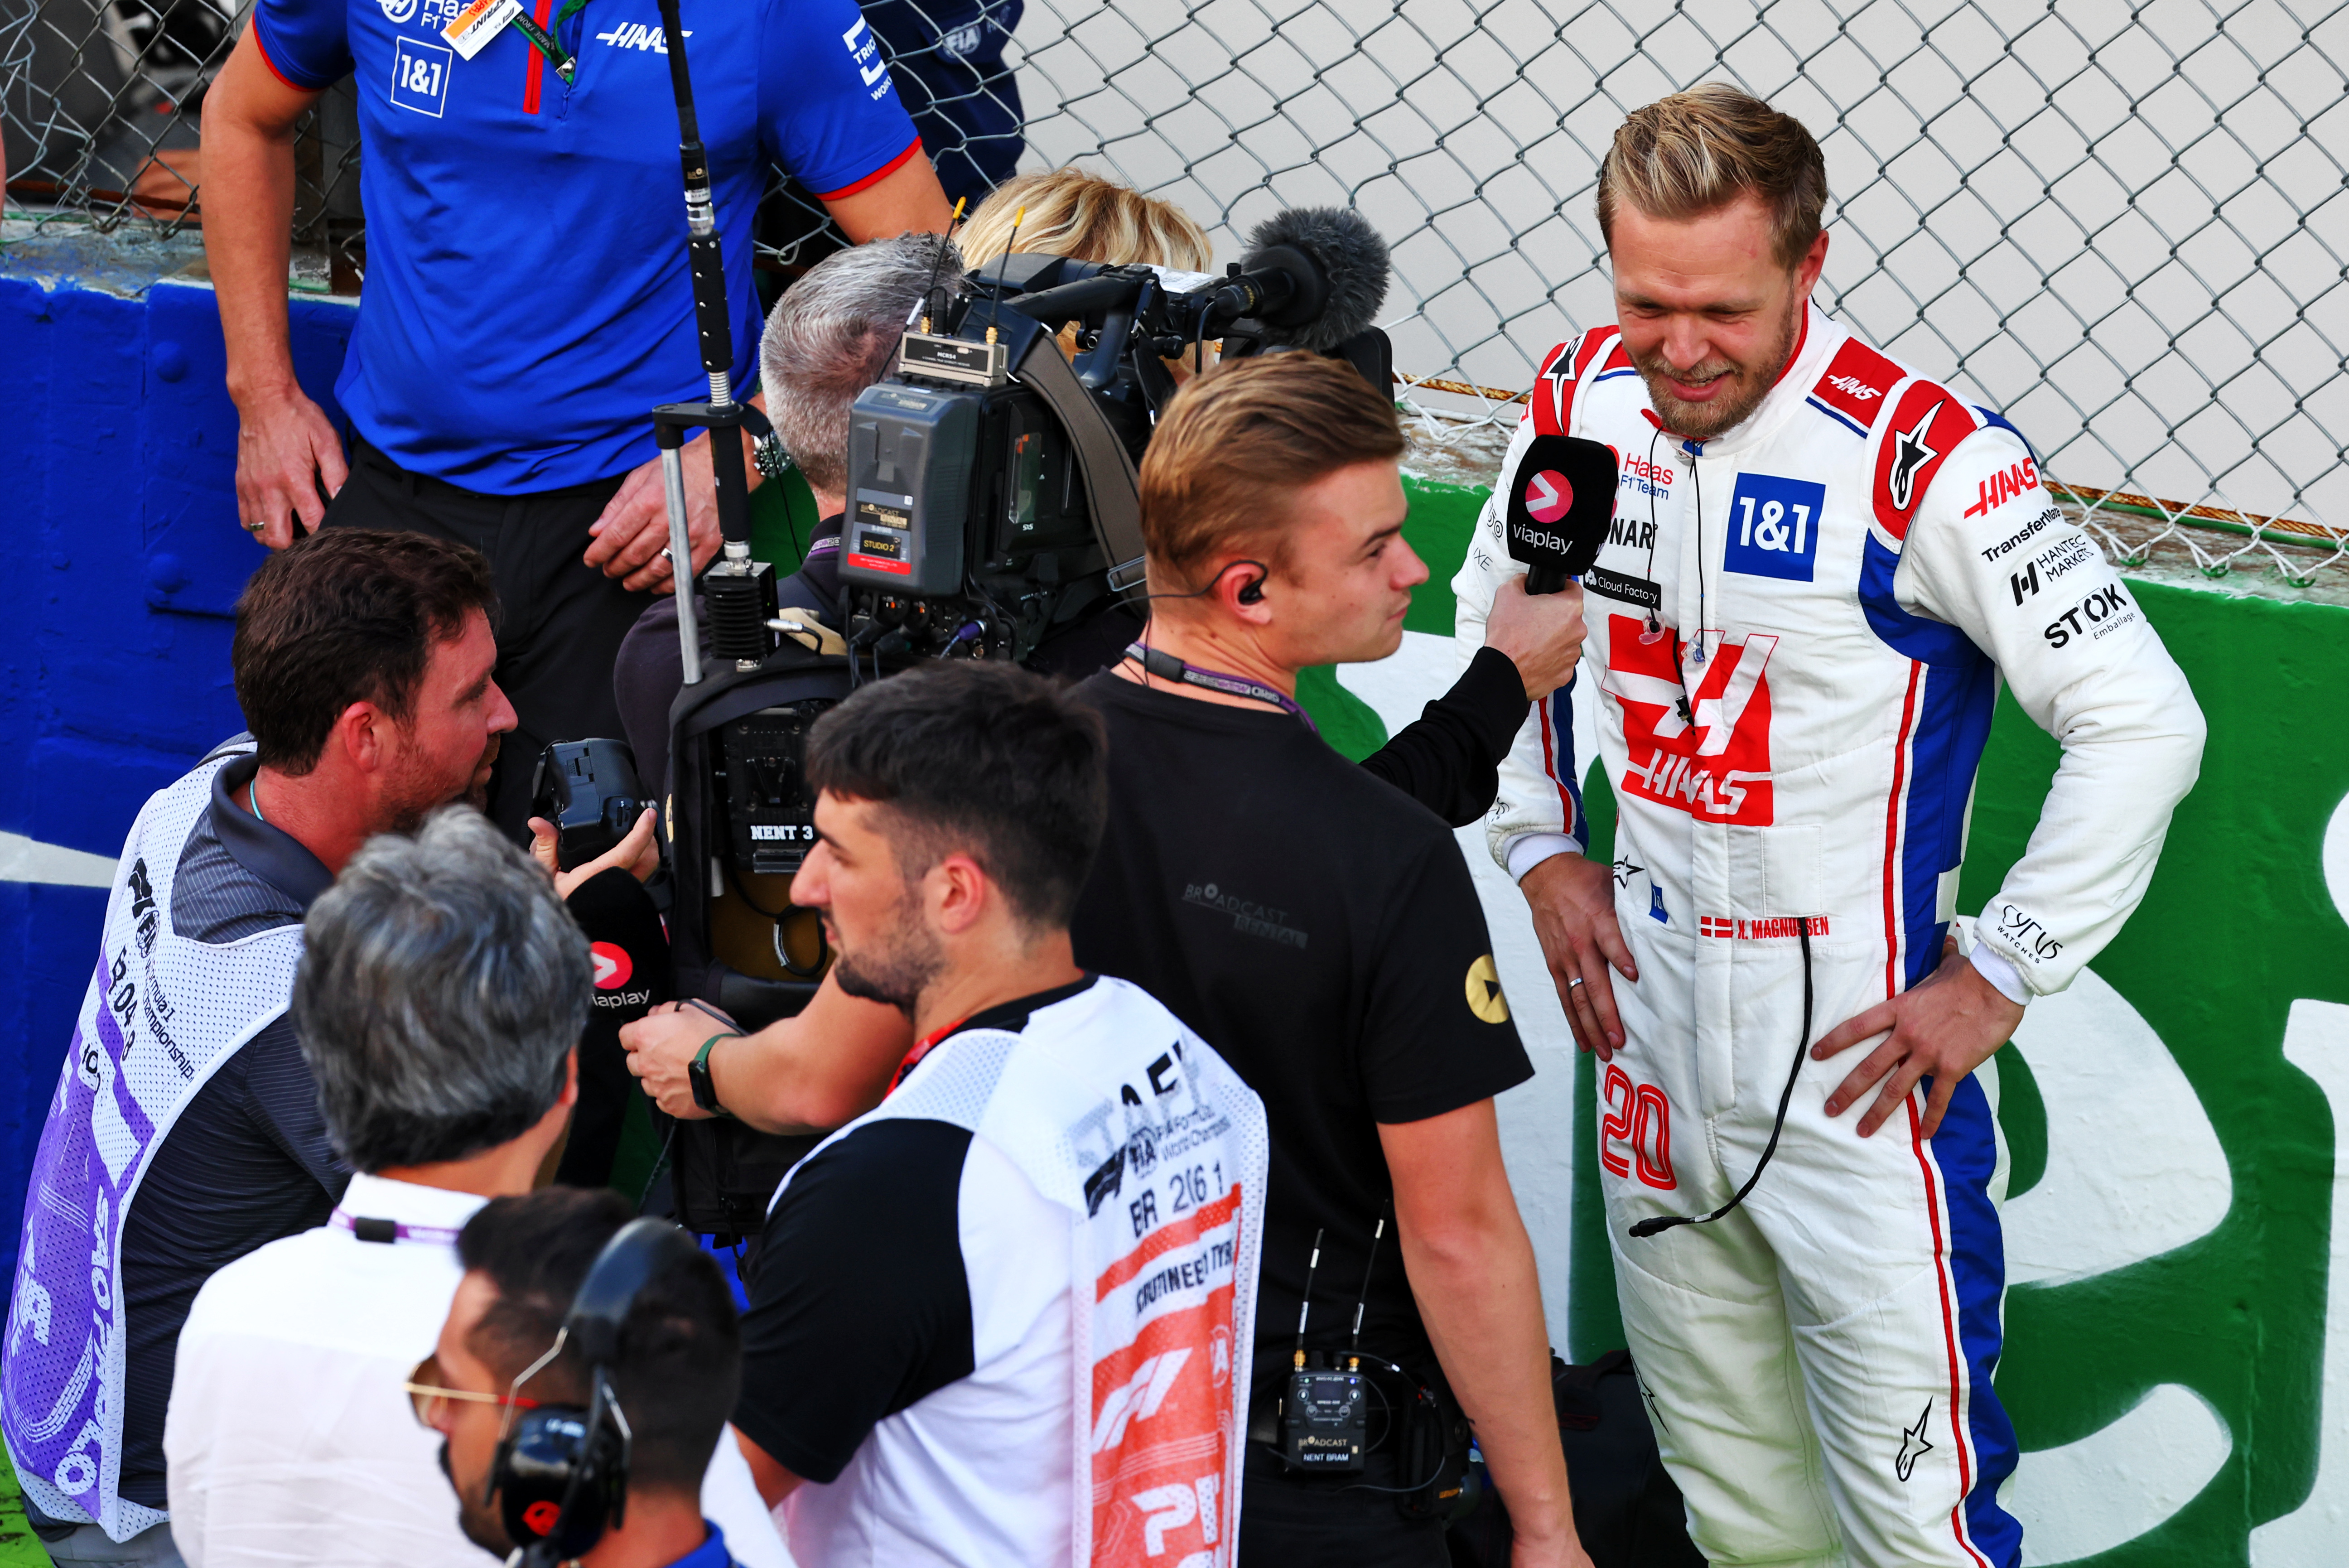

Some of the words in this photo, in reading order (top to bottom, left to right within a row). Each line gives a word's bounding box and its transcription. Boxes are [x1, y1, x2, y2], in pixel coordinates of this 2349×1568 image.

[516, 14, 535, 32] FROM
[400, 54, 442, 96] 1&1
[1827, 374, 1882, 400] HAAS
[1624, 452, 1674, 485] Haas
[1637, 478, 1669, 500] Team
[1963, 457, 2038, 520] HAAS
[1513, 523, 1573, 556] viaplay
[1738, 497, 1811, 555] 1&1
[1981, 507, 2061, 563] TransferMate
[863, 539, 889, 552] STUDIO
[2036, 535, 2086, 569] HANTEC
[2045, 548, 2094, 583] MARKETS
[1598, 576, 1622, 593] Cloud
[2044, 583, 2127, 649] STOK
[2093, 611, 2136, 640] Emballage
[1626, 748, 1772, 815] HAAS
[750, 825, 798, 841] NENT
[802, 825, 814, 840] 3
[1184, 882, 1288, 925] BROADCAST
[1997, 925, 2040, 964] WATCHES
[591, 989, 651, 1009] iaplay
[1601, 1063, 1677, 1191] 20
[1297, 1435, 1348, 1448] BROADCAST
